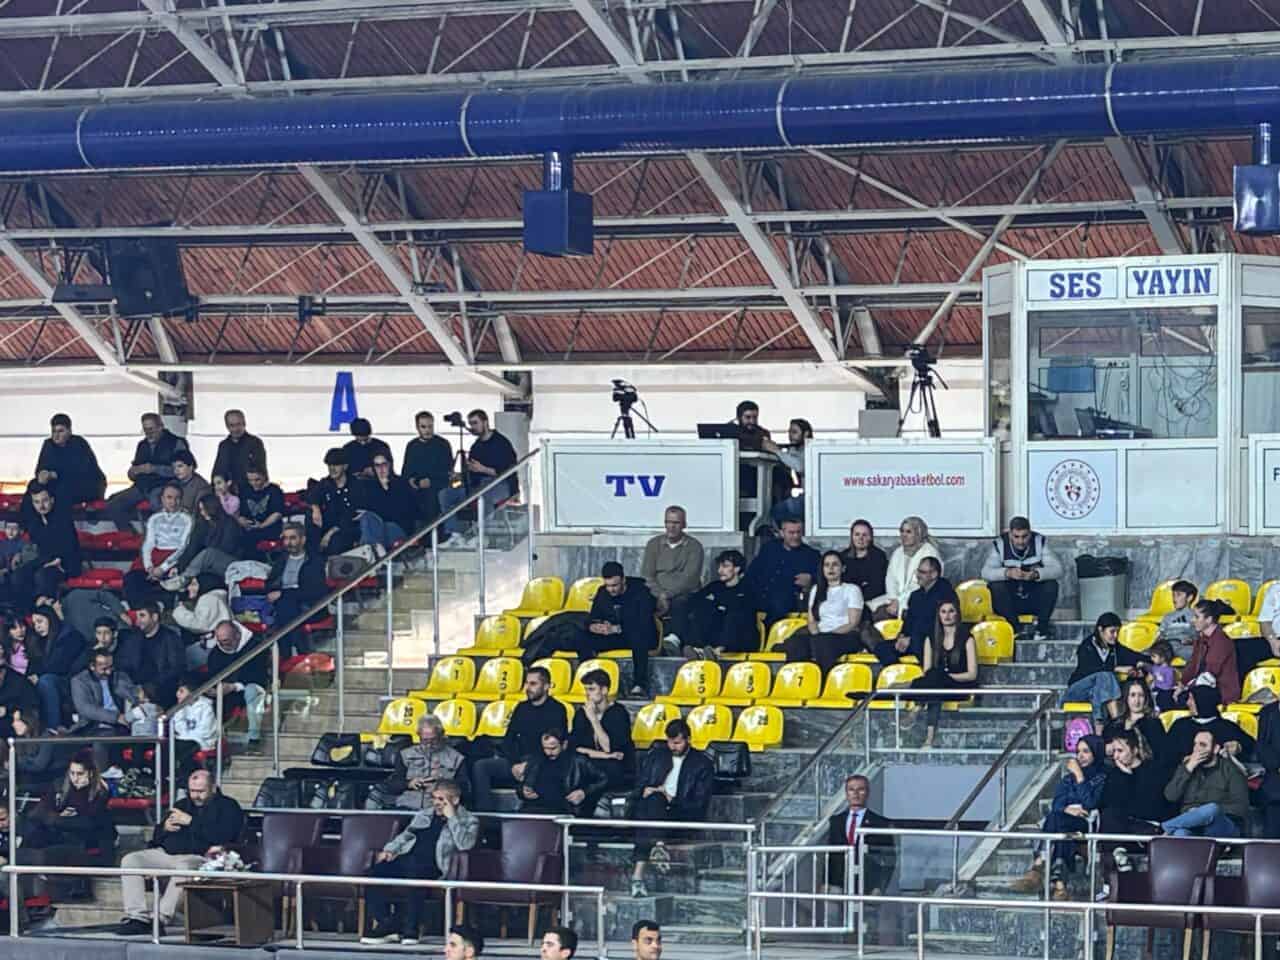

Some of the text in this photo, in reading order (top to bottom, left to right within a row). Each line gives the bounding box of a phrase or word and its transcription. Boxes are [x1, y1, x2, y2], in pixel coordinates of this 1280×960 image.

[1050, 267, 1212, 298] SES YAYIN
[329, 371, 358, 432] A
[605, 475, 666, 497] TV
[843, 473, 965, 489] www.sakaryabasketbol.com
